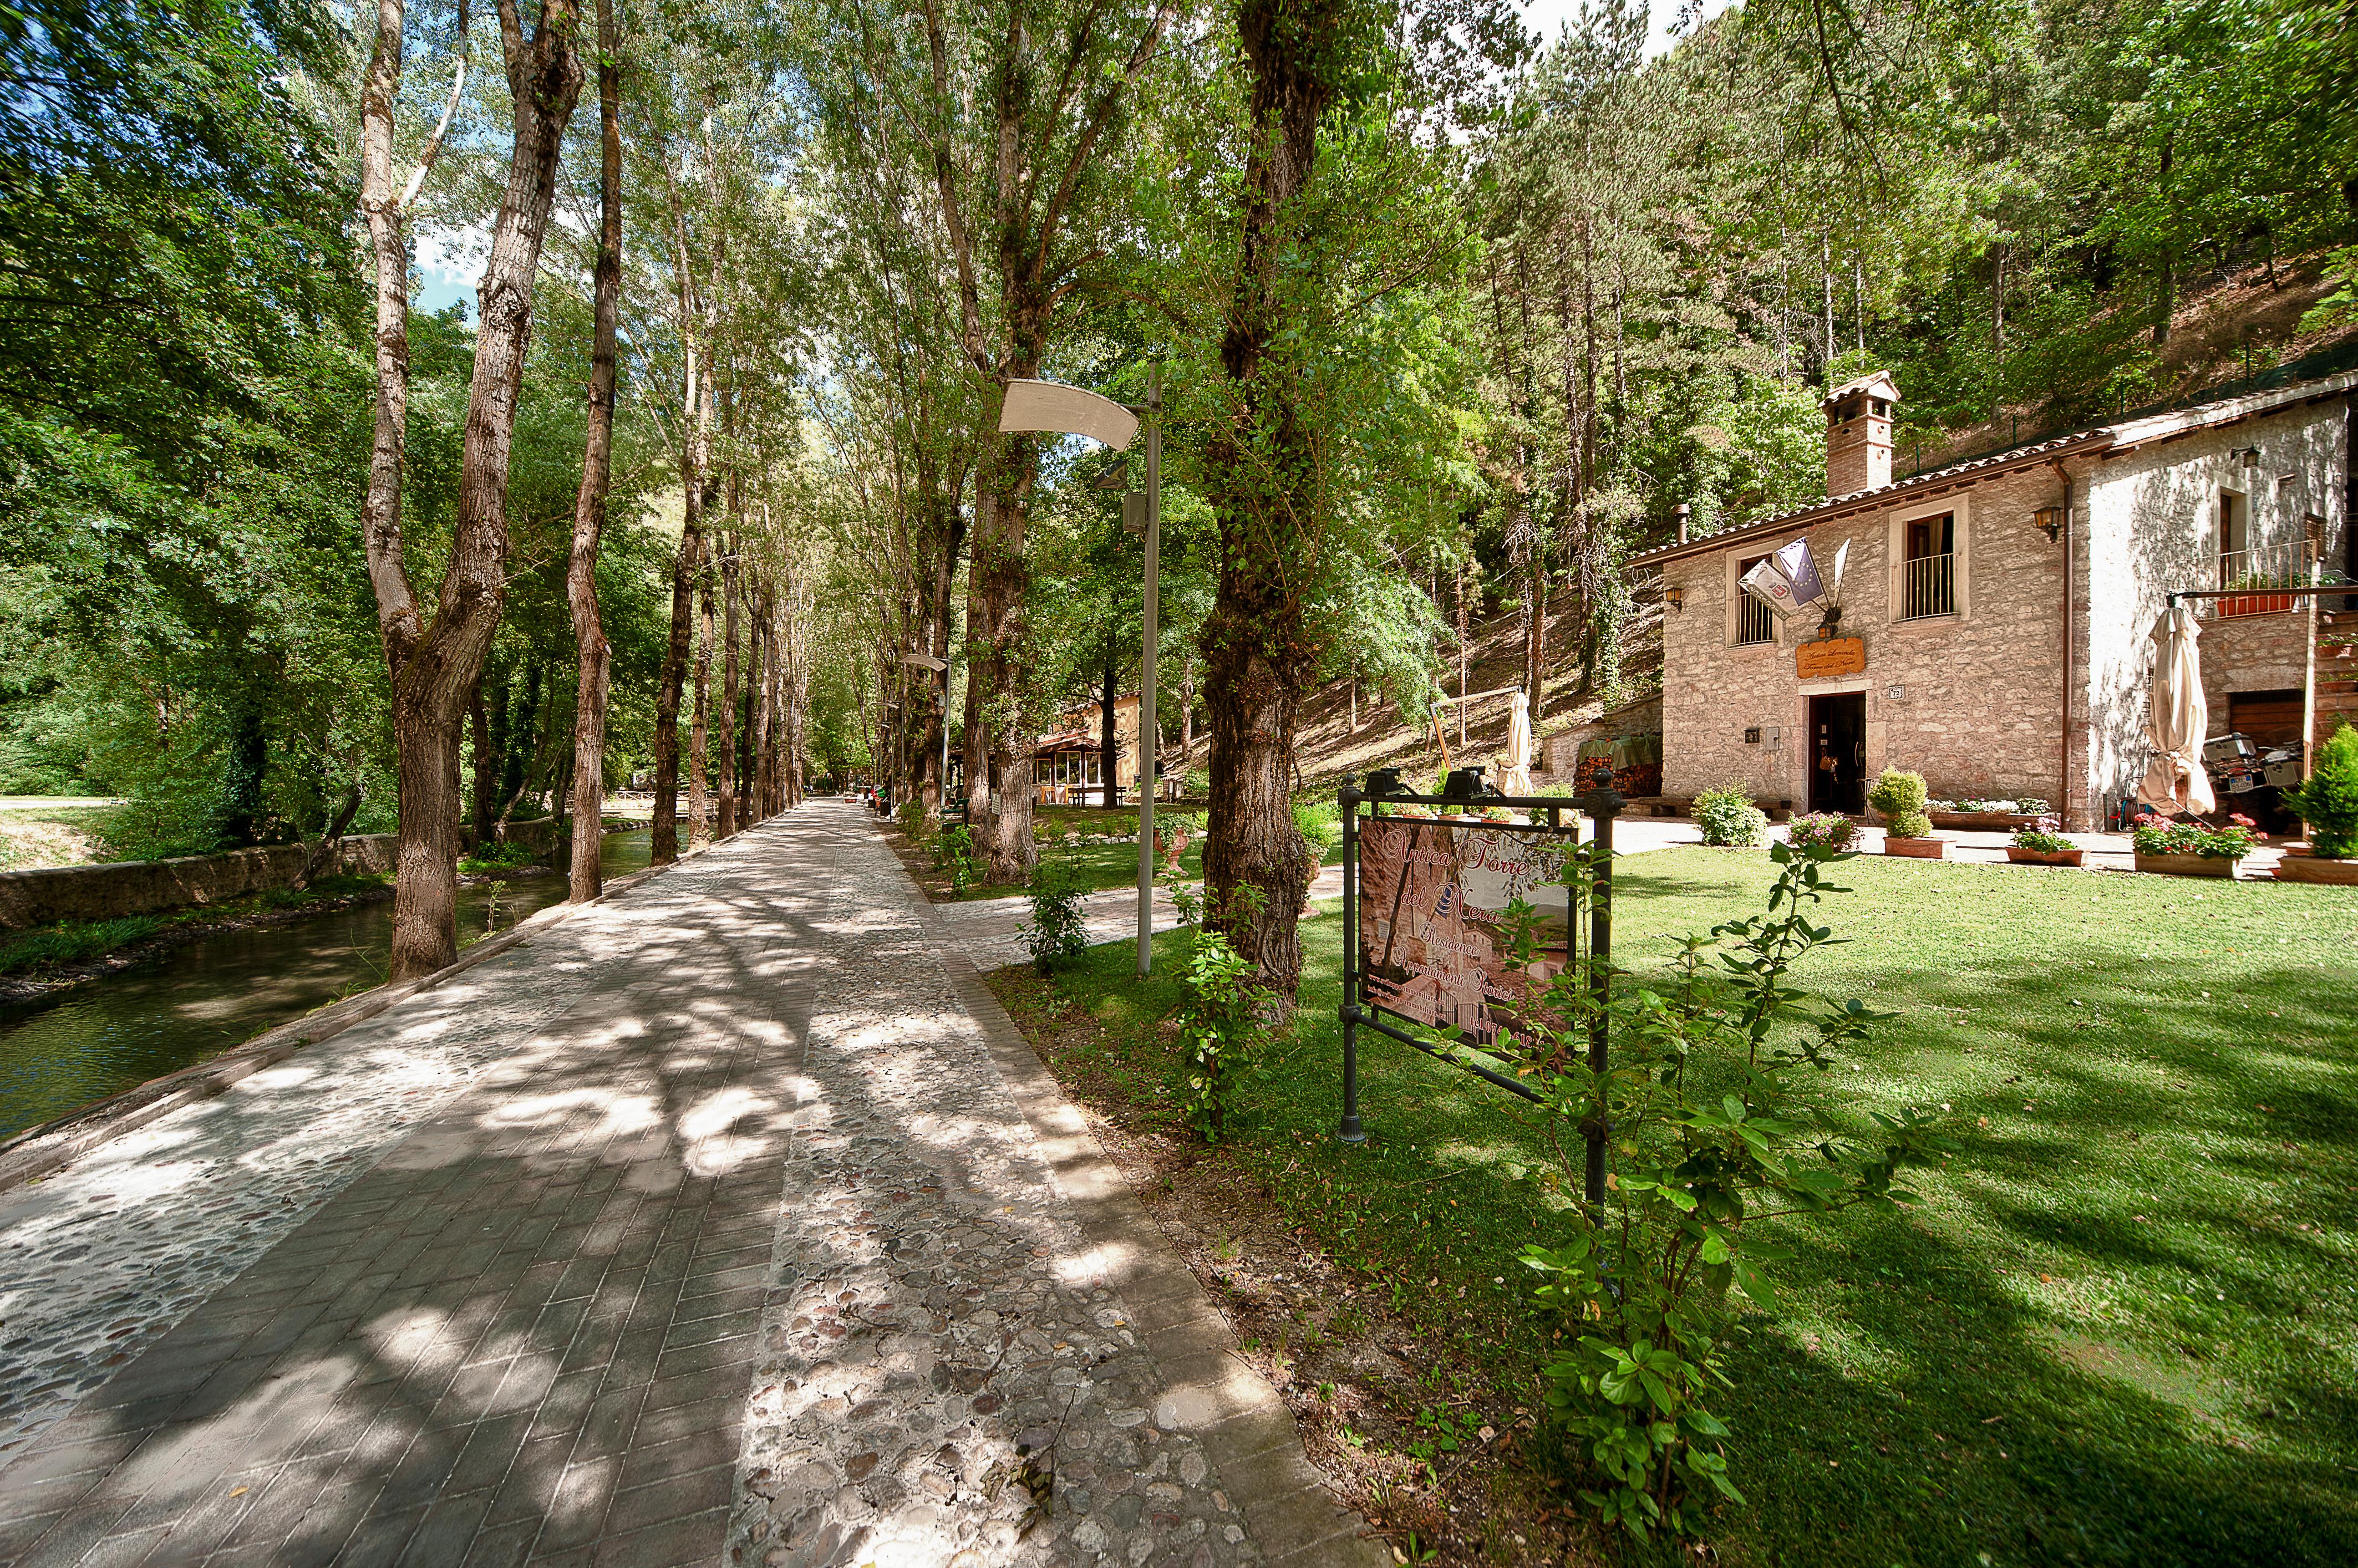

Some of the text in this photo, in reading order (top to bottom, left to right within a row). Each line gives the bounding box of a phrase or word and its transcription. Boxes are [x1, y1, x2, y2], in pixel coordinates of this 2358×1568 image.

[1805, 648, 1855, 661] Antica Locanda
[1835, 658, 1856, 668] Nera
[1381, 829, 1532, 877] Antica Torre
[1400, 882, 1502, 925] del Nera
[1418, 921, 1480, 958] Residence
[1392, 945, 1516, 1001] Appartamenti Storici
[1470, 1015, 1484, 1031] tel
